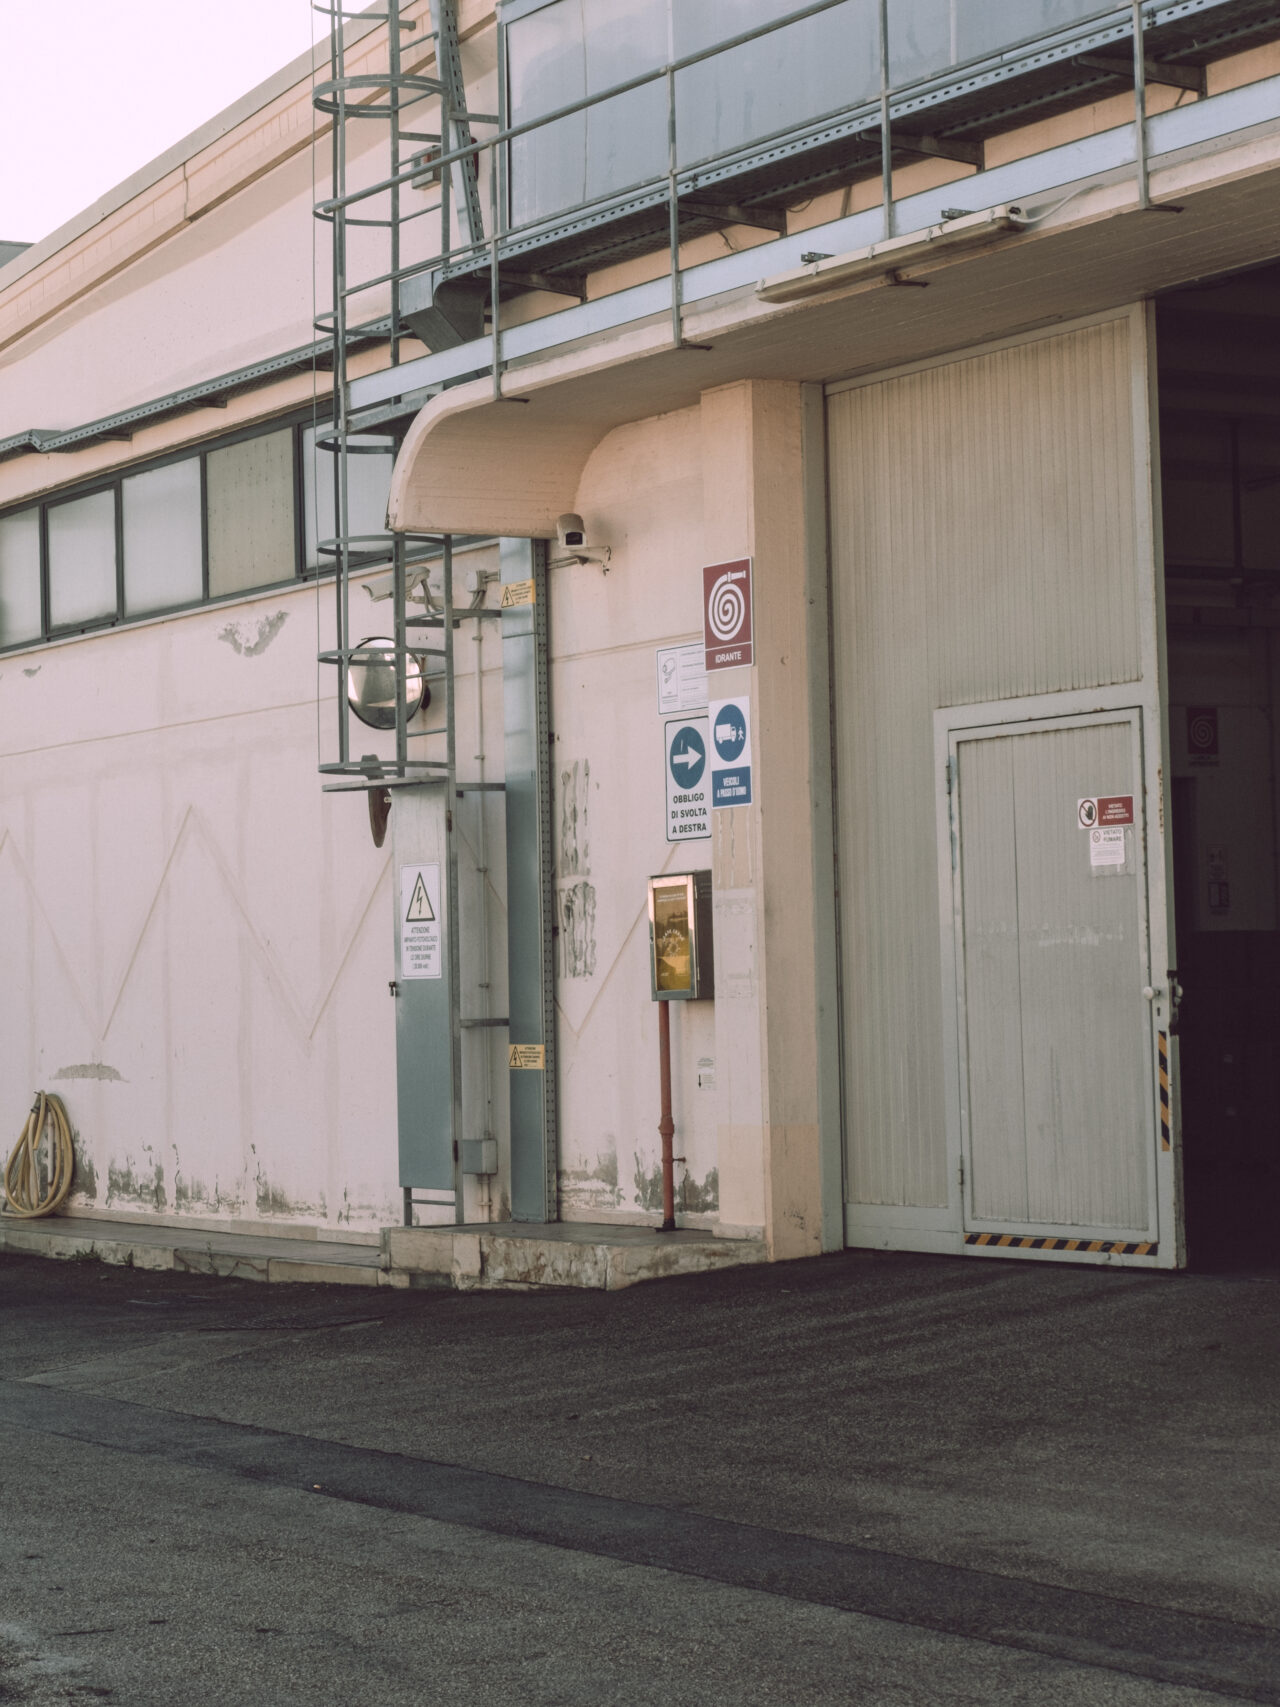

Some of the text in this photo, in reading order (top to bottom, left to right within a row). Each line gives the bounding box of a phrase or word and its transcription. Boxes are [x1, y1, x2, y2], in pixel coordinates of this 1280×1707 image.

[715, 651, 742, 664] IDRANTE
[673, 793, 705, 804] OBBLIGO
[671, 808, 707, 819] DI SVOLTA
[672, 823, 707, 834] A DESTRA
